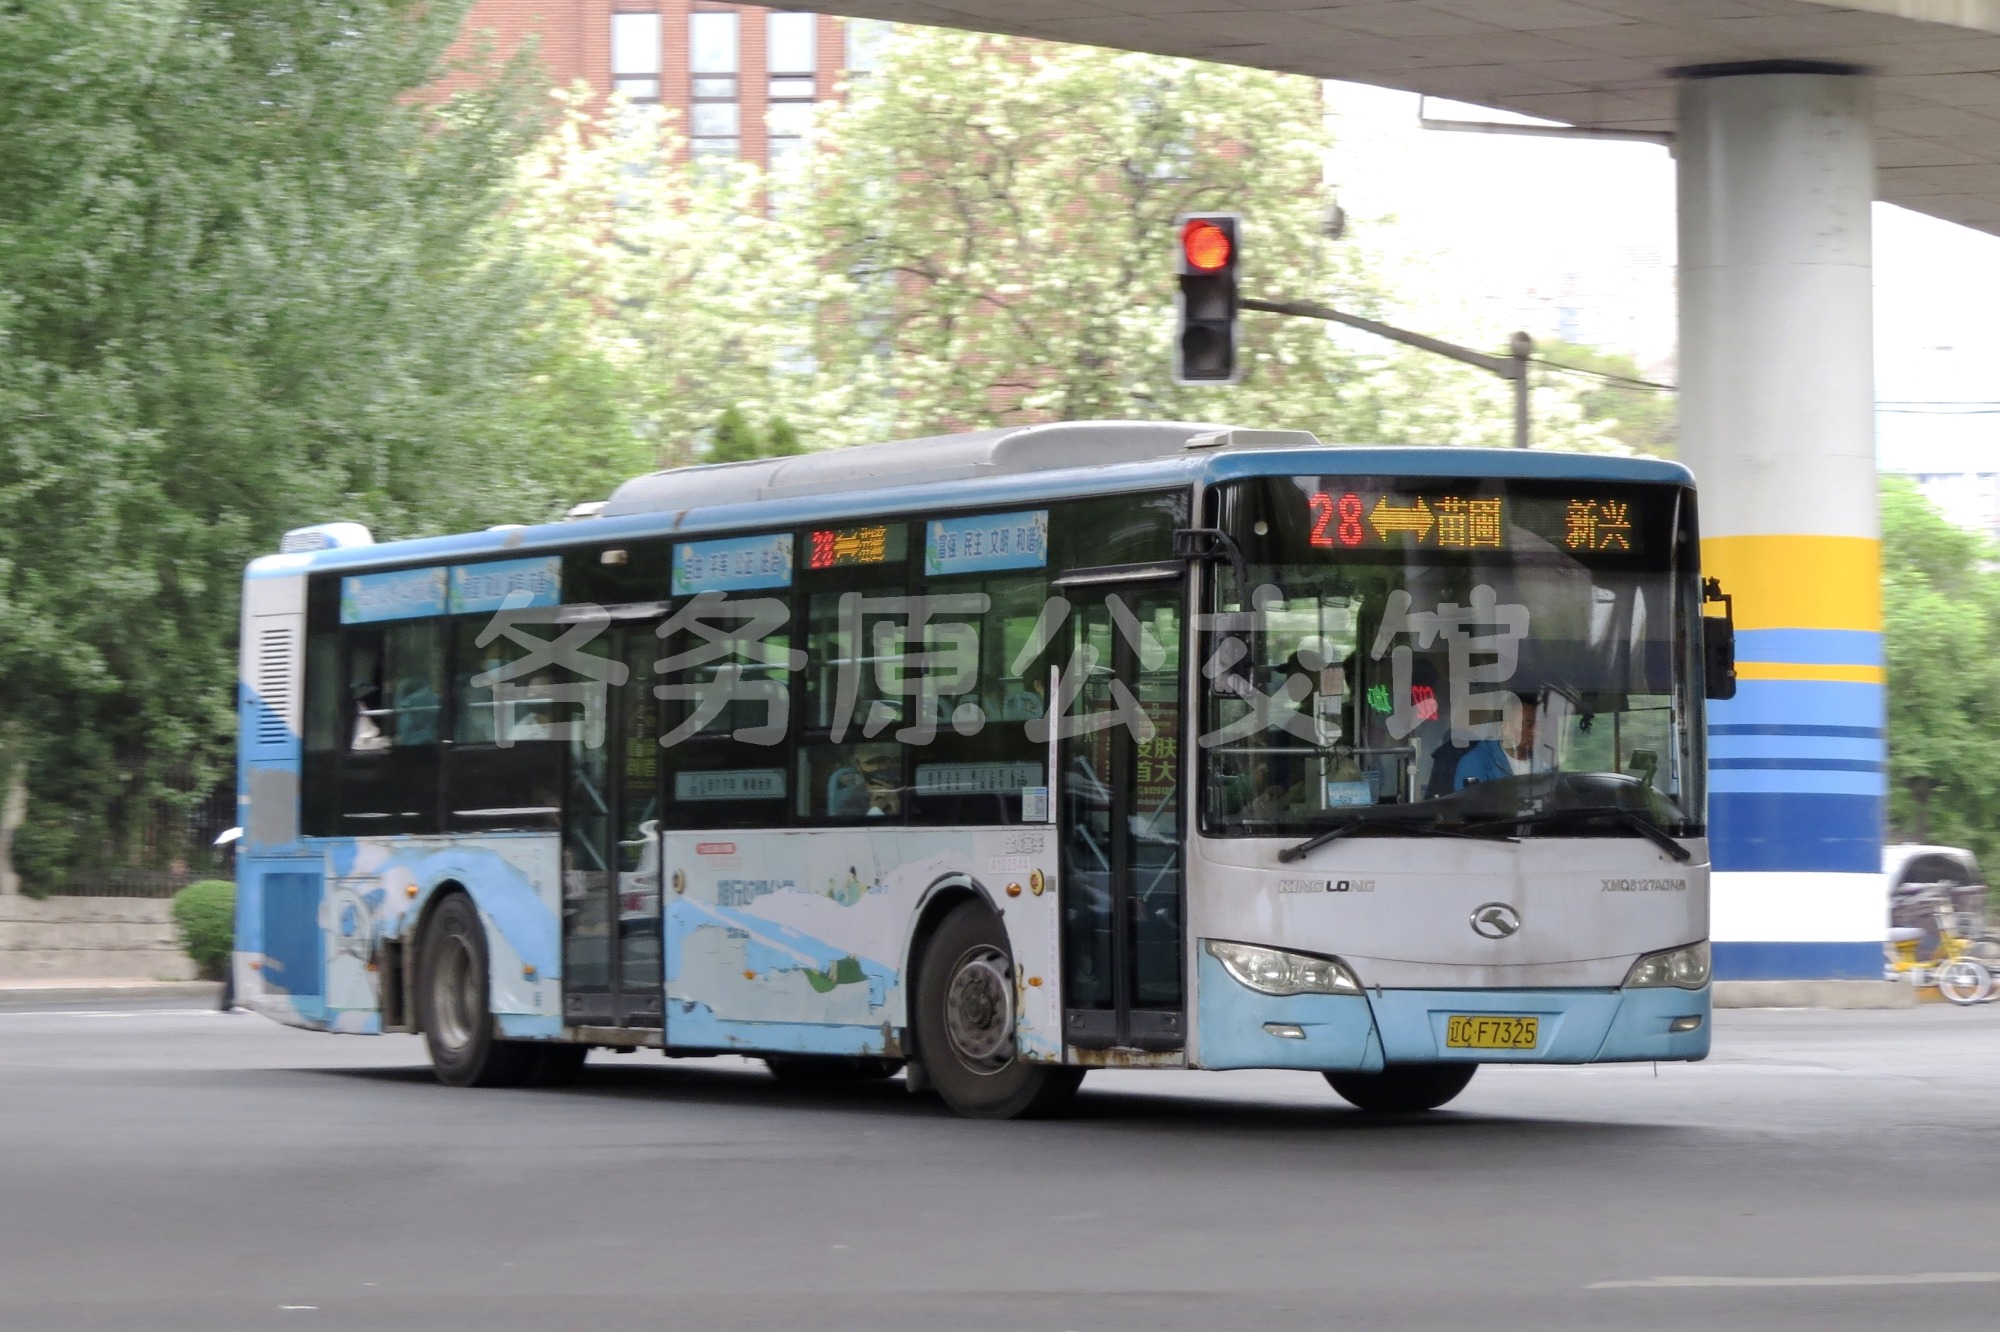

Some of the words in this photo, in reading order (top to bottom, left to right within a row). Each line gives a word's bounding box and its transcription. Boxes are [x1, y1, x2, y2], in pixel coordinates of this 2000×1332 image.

[1308, 493, 1365, 548] 28
[1566, 499, 1632, 549] 新兴
[810, 530, 835, 568] 28
[964, 530, 983, 557] 民主
[989, 527, 1010, 555] 文明
